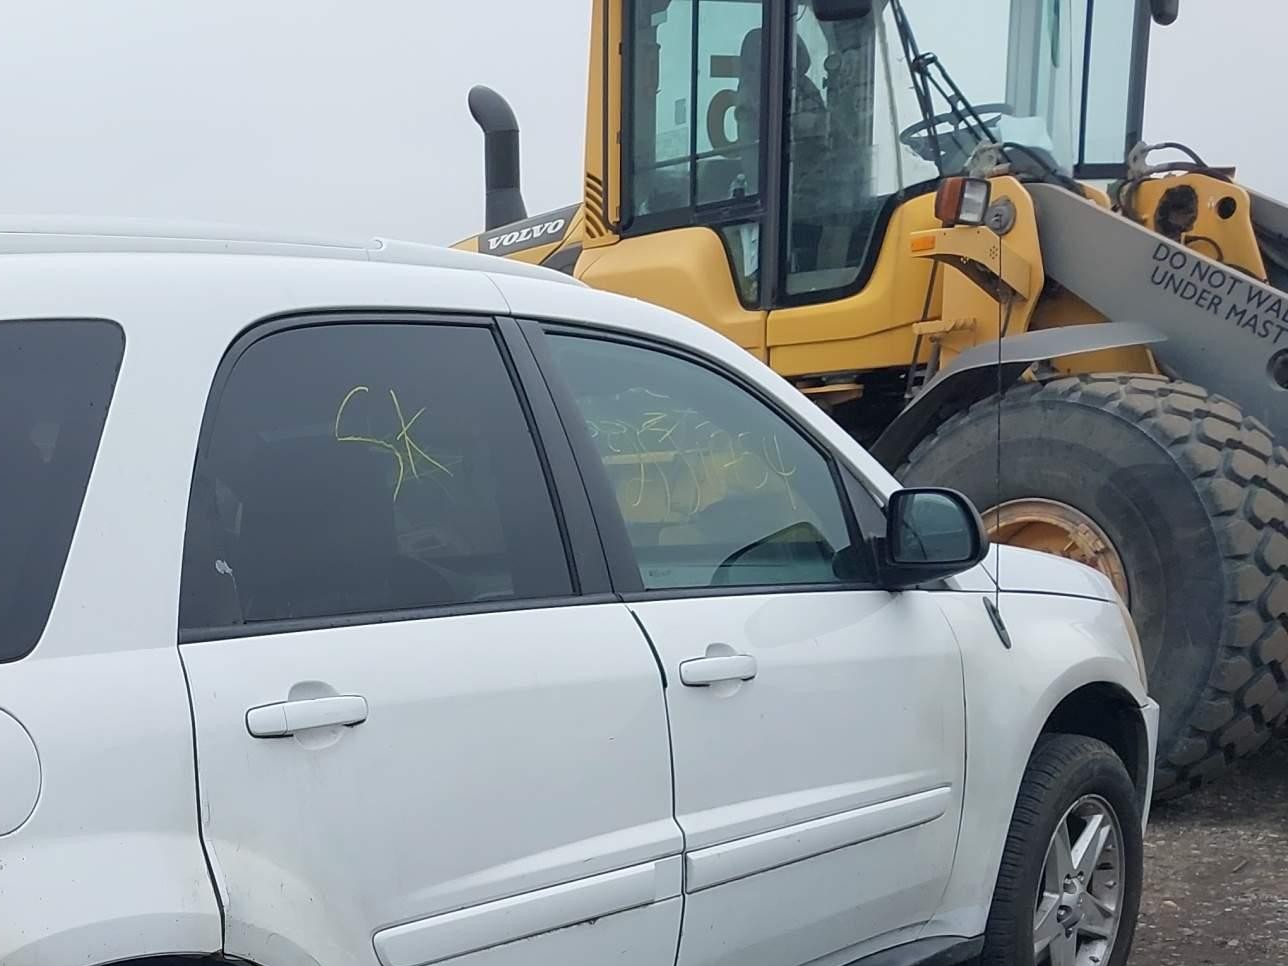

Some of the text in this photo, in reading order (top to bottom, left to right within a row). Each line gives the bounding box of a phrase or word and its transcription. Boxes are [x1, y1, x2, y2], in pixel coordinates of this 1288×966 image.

[487, 218, 565, 250] VOLVO
[1152, 242, 1187, 270] DO
[1190, 261, 1242, 296] NOT
[1150, 265, 1288, 345] UNDER MAST
